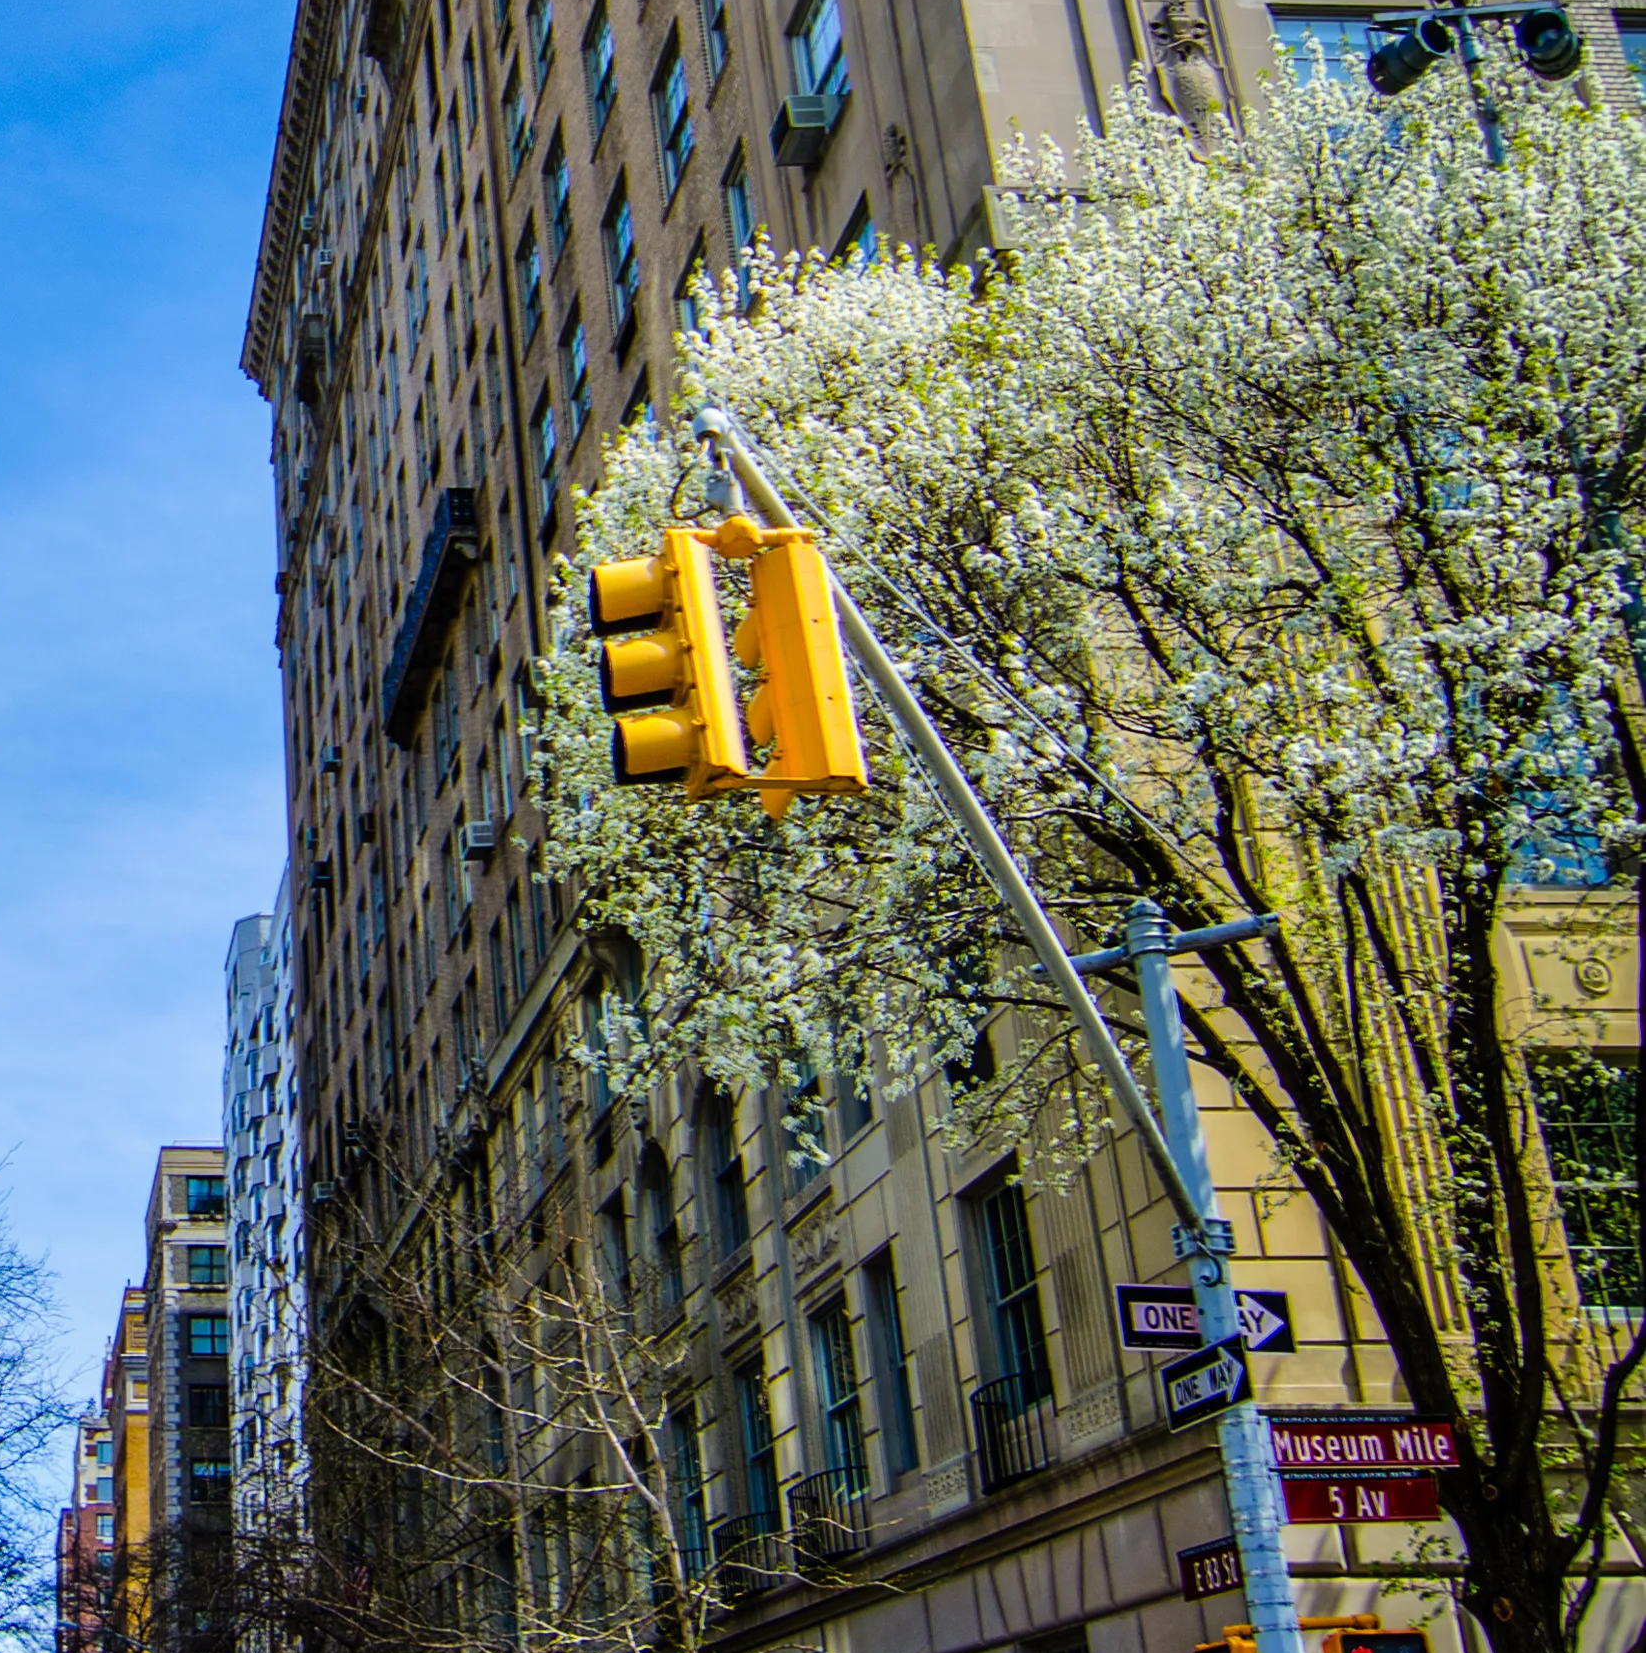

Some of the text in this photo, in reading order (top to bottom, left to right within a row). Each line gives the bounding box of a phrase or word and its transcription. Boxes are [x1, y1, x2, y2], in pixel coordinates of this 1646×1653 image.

[1144, 1305, 1266, 1334] ONE AY
[1174, 1356, 1235, 1407] ONE WAY
[1272, 1425, 1451, 1462] Museum Mile
[1328, 1484, 1386, 1518] 5 Av
[1193, 1550, 1239, 1592] E 83 St
